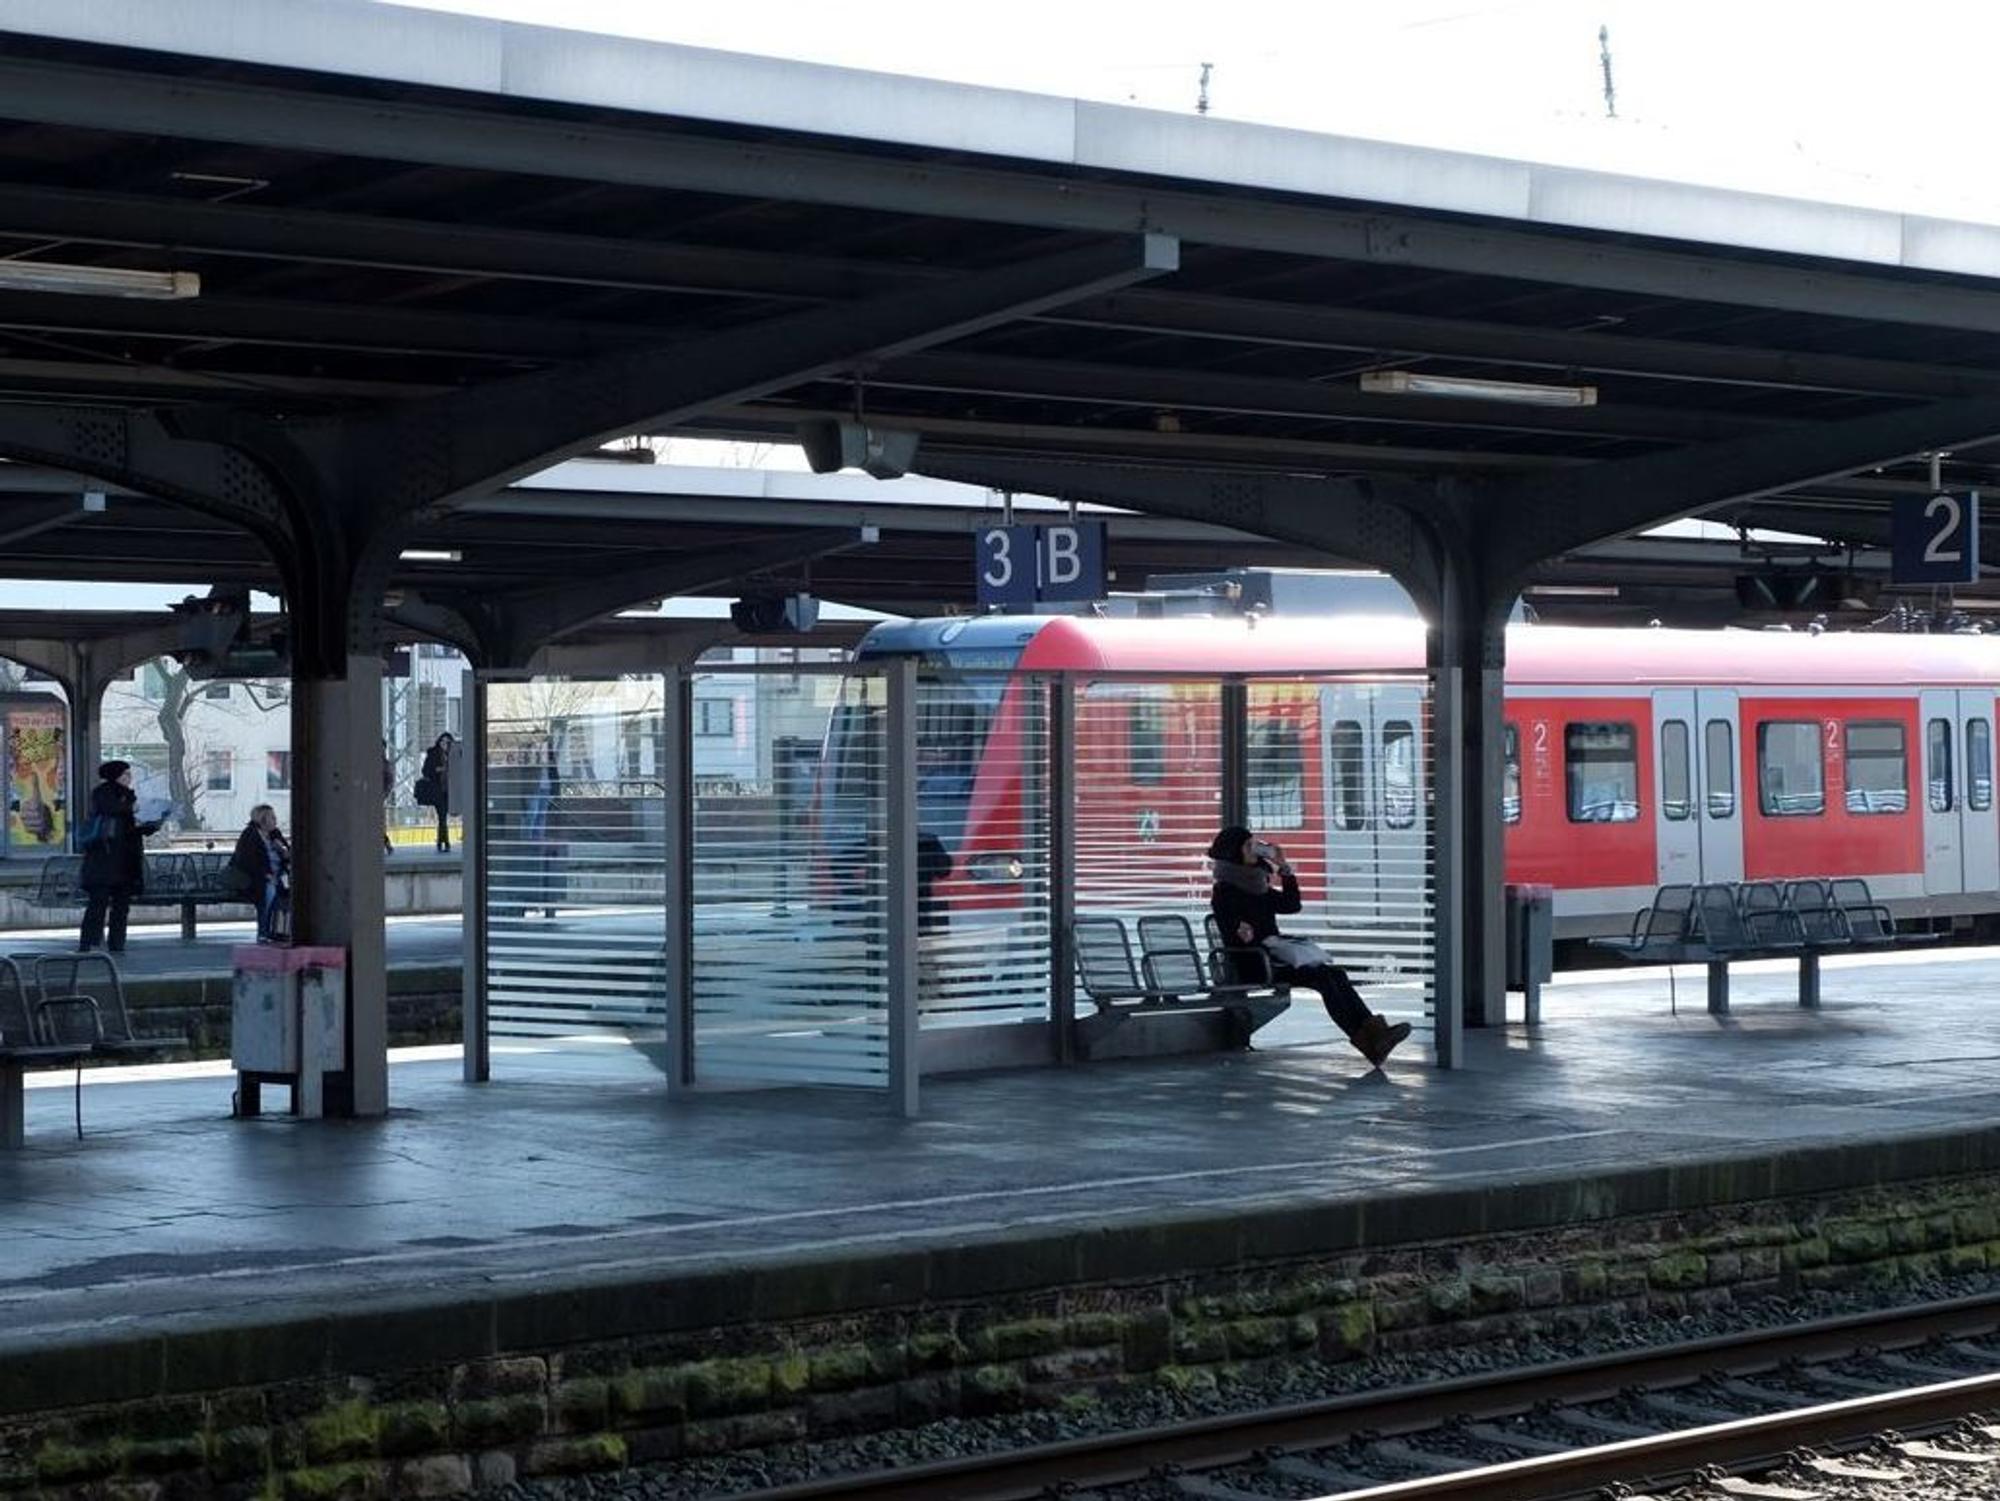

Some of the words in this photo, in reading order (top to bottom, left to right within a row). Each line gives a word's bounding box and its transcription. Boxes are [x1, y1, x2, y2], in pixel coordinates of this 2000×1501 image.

[1924, 495, 1961, 562] 2
[984, 529, 1012, 587] 3
[1047, 527, 1081, 583] B
[1534, 722, 1548, 752] 2
[1827, 720, 1839, 749] 2
